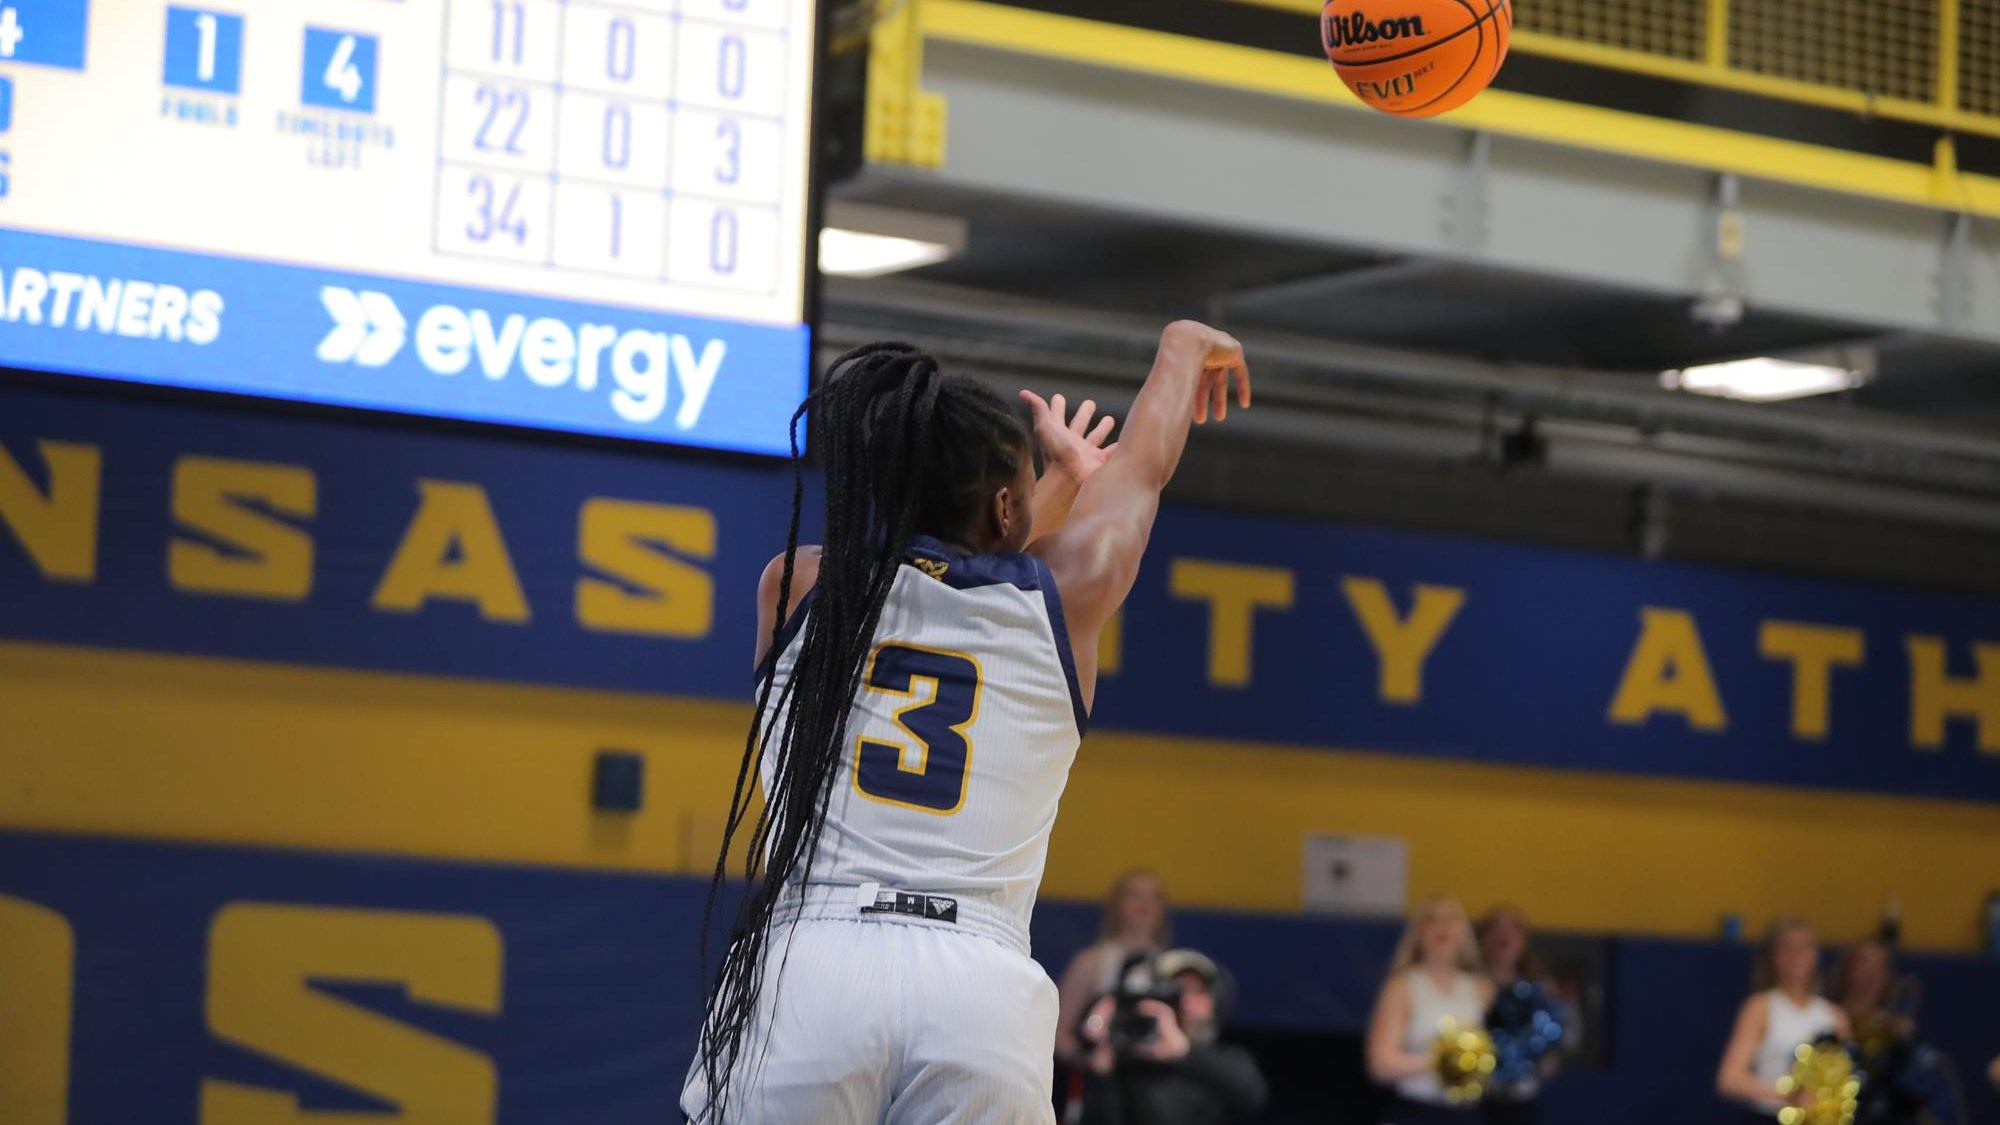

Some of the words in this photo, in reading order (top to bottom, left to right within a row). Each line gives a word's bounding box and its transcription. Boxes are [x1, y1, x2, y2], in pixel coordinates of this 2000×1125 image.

[194, 13, 217, 82] 1
[323, 34, 363, 103] 4
[491, 0, 526, 64] 11
[606, 16, 636, 82] 0
[717, 34, 747, 99] 0
[1325, 12, 1424, 48] Wilson
[473, 84, 531, 156] 22
[602, 102, 632, 169] 0
[714, 118, 743, 185] 3
[465, 174, 528, 247] 34
[609, 192, 624, 260] 1
[708, 207, 740, 276] 0
[0, 266, 225, 346] RTNERS
[415, 303, 728, 430] evergy
[852, 639, 984, 816] 3
